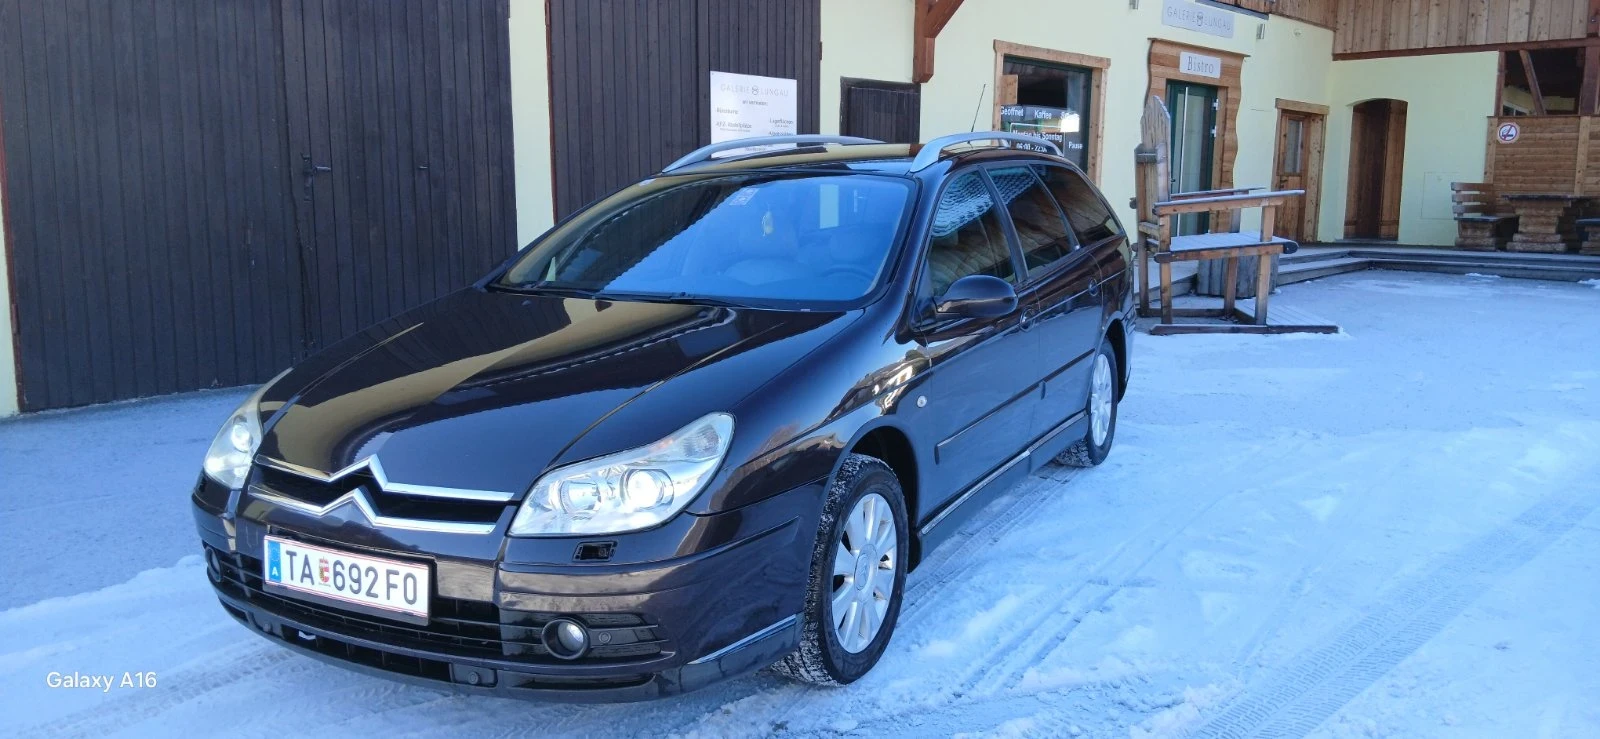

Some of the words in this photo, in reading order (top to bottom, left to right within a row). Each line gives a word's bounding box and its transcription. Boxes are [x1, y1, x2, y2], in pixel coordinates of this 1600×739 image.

[1166, 6, 1195, 23] GALERIE
[1204, 15, 1231, 31] LUNGAU
[1187, 56, 1214, 74] Bistro
[720, 83, 750, 94] GALERIE
[760, 87, 789, 97] LUNGAU
[1000, 106, 1024, 117] Geöffnet
[1034, 109, 1052, 120] Kaffee
[1041, 131, 1063, 142] Sonntag
[1068, 141, 1083, 150] Pause
[271, 566, 279, 576] A
[286, 550, 315, 586] TA
[333, 559, 379, 599] 692
